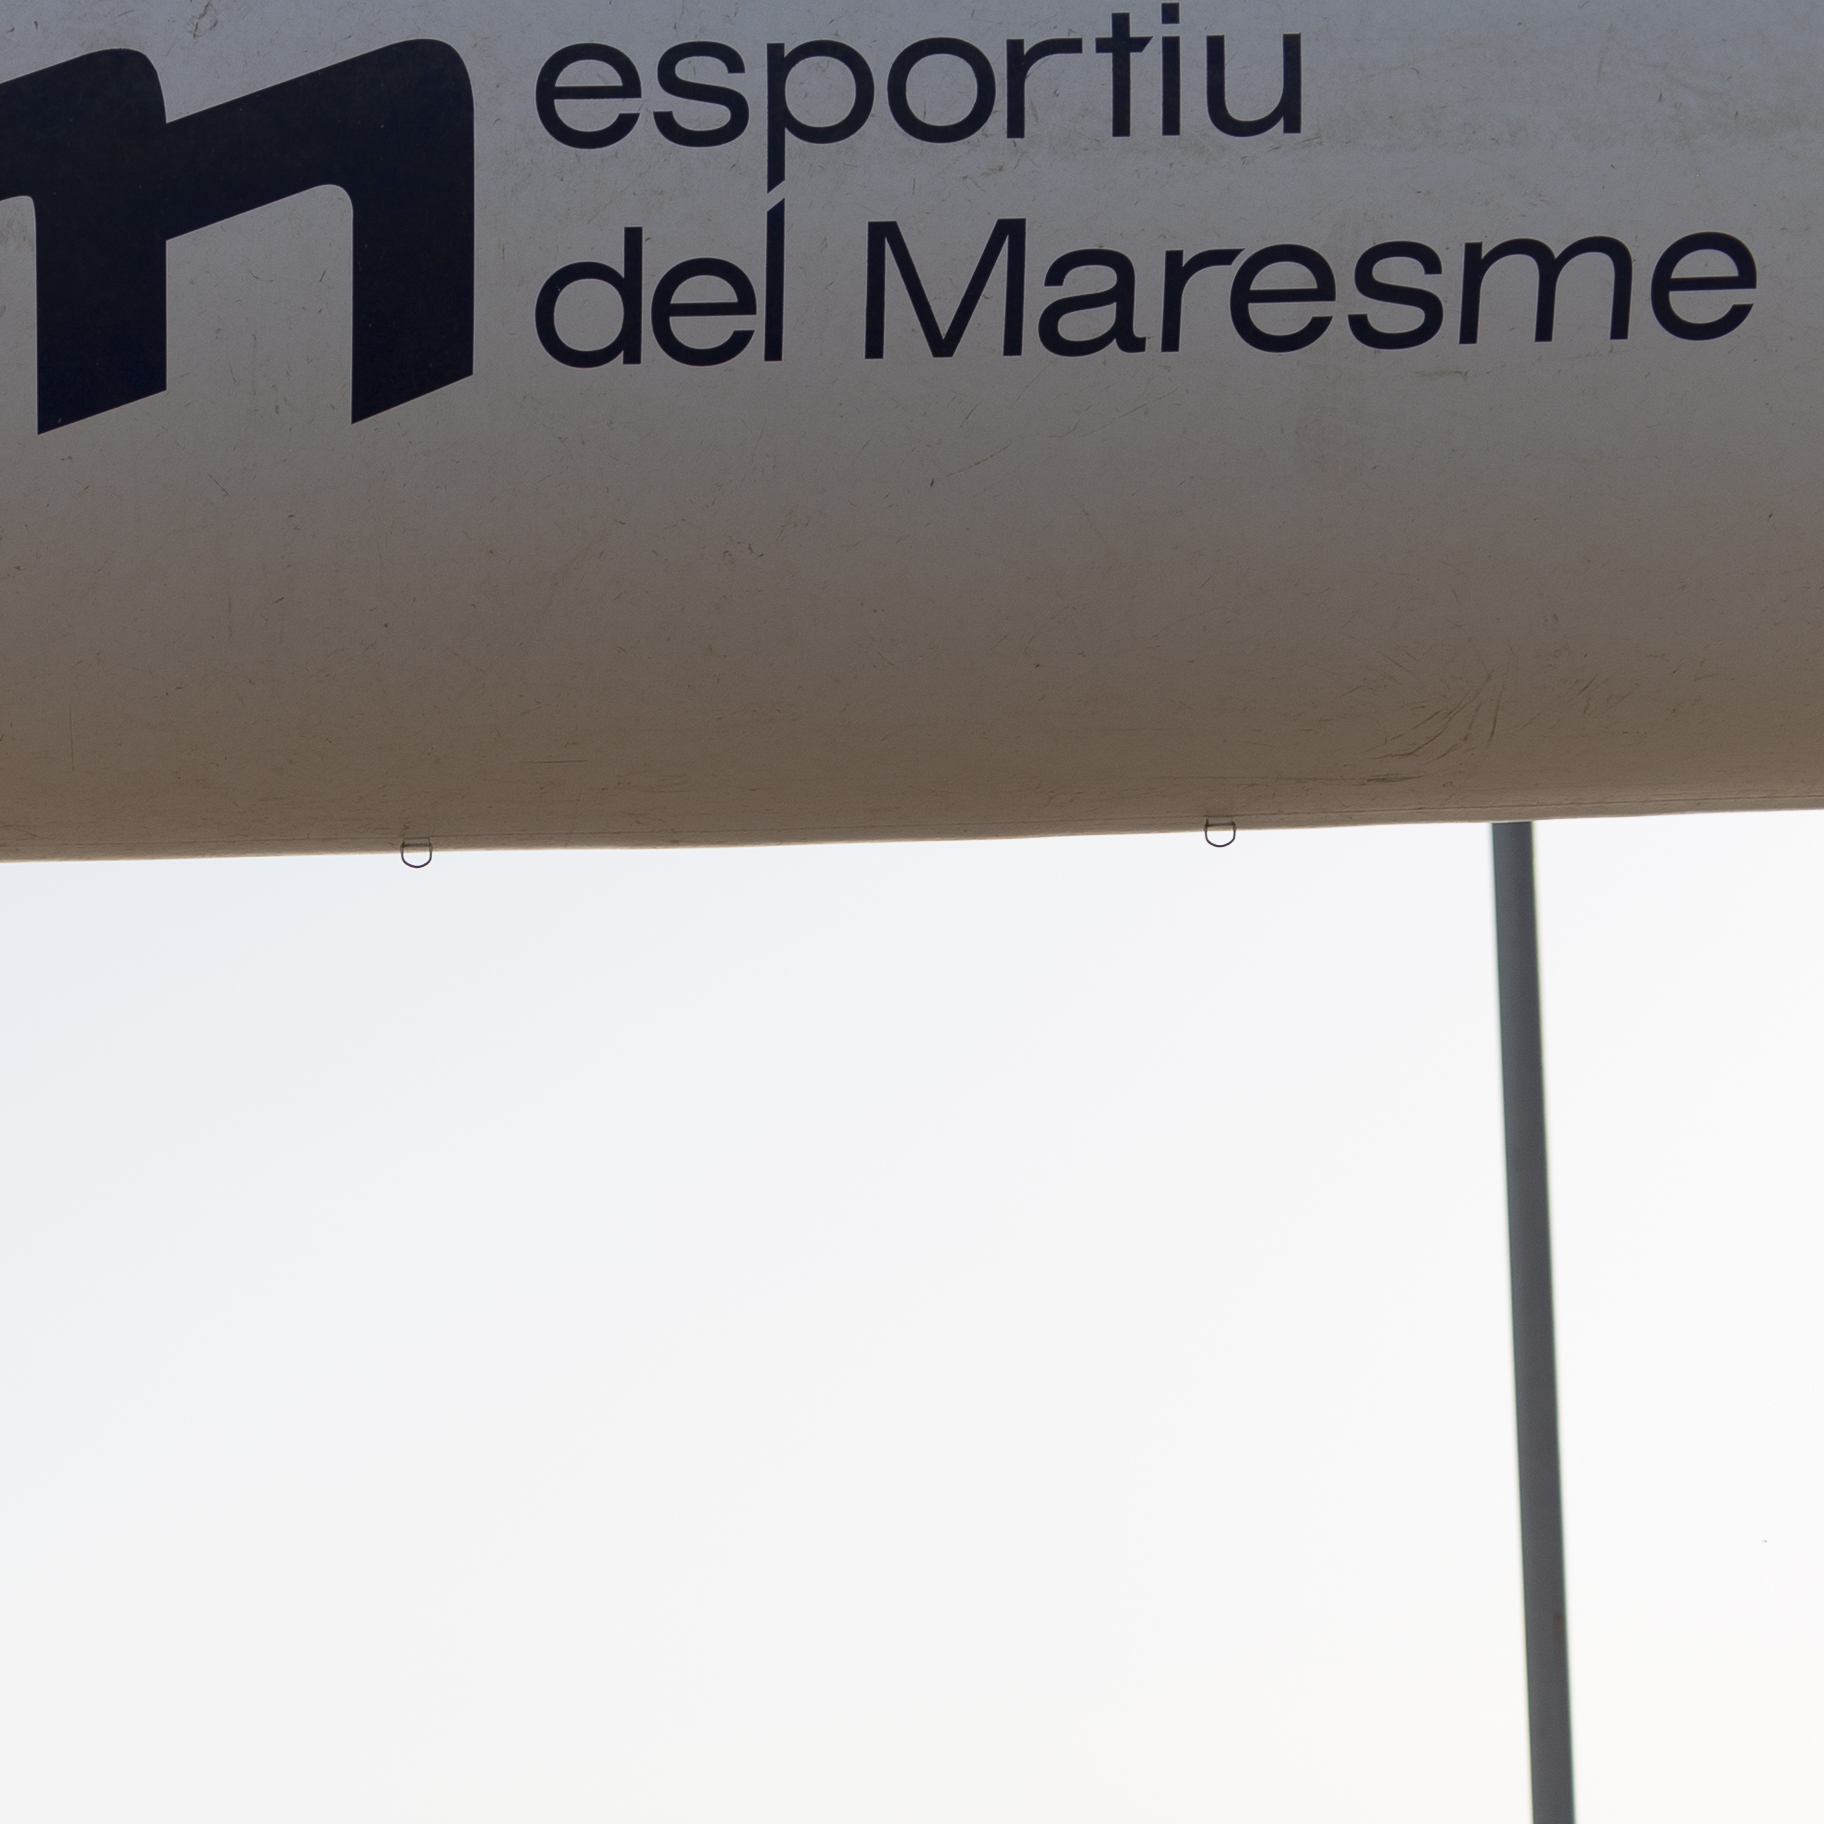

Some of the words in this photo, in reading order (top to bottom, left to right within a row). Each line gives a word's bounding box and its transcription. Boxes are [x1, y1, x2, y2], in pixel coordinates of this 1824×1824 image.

[534, 2, 1303, 194] esportiu
[534, 199, 786, 369] del
[863, 217, 1759, 361] Maresme
